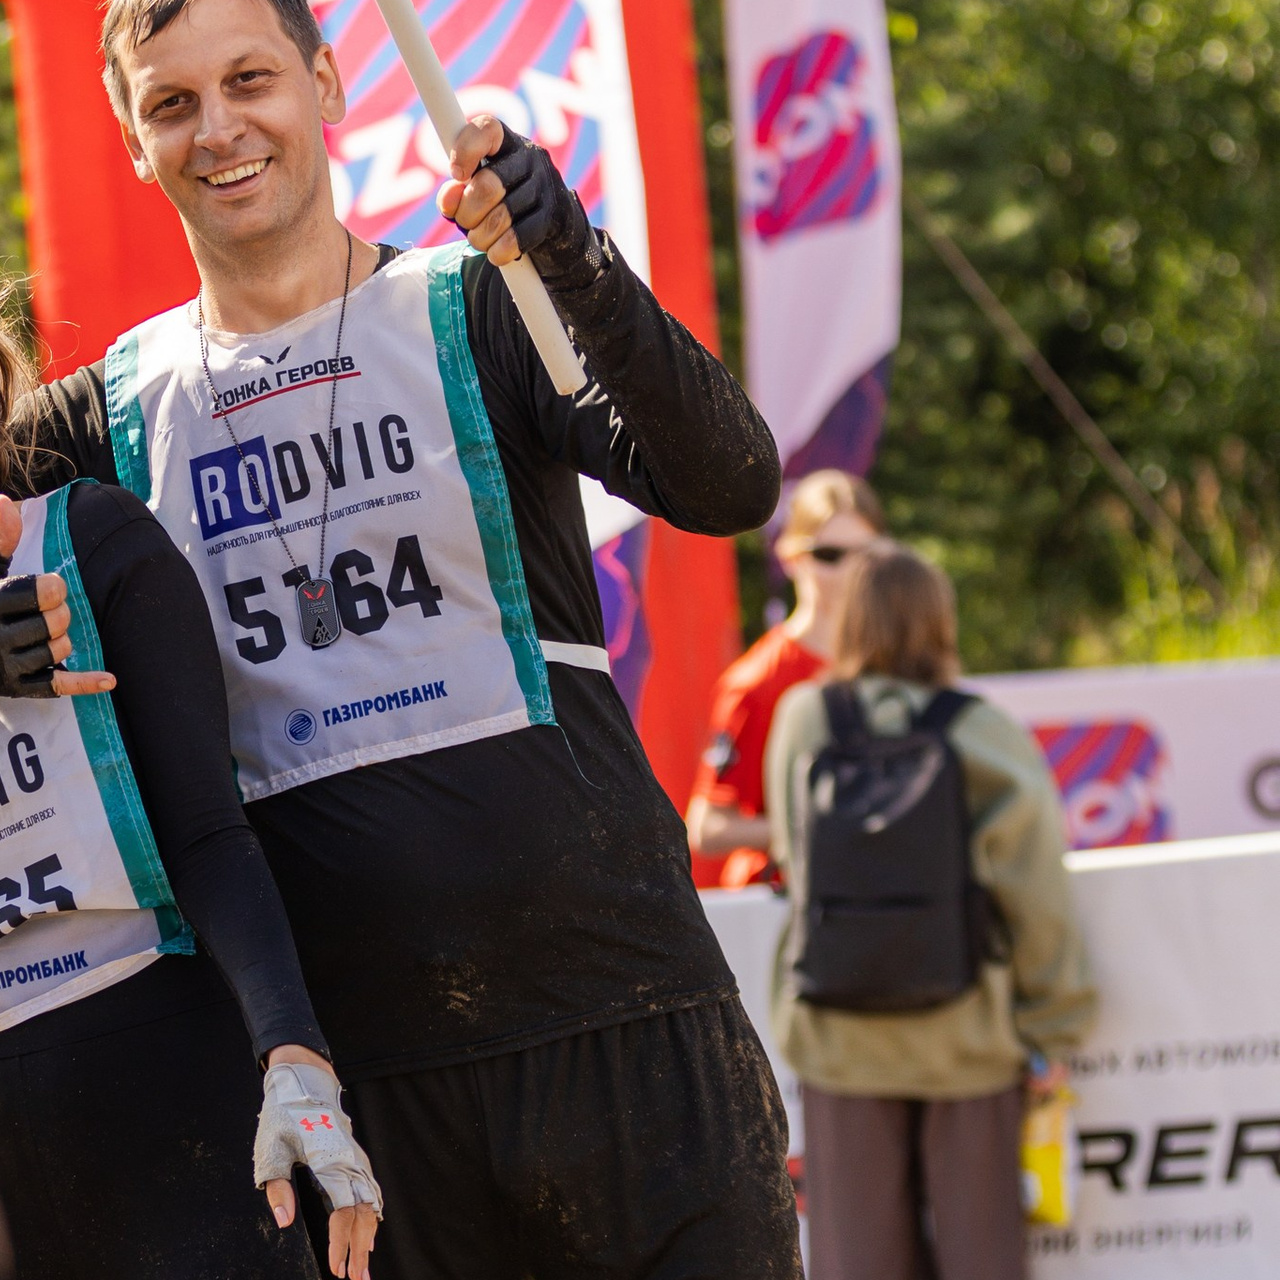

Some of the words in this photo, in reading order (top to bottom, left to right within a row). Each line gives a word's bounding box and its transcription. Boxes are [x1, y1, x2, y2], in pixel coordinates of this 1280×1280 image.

[214, 376, 272, 412] ГОНКА
[275, 356, 356, 387] ГЕРОЕВ
[199, 414, 416, 527] RODVIG
[206, 536, 249, 557] НАДЕЖНОСТЬ
[249, 531, 265, 545] ДЛЯ
[329, 496, 387, 522] БЛАГОСОСТОЯНИЕ
[387, 492, 404, 506] ДЛЯ
[403, 489, 422, 501] ВСЕХ
[322, 680, 448, 727] ГАЗПРОМБАНК
[25, 813, 40, 828] ДЛЯ
[39, 806, 57, 822] ВСЕХ
